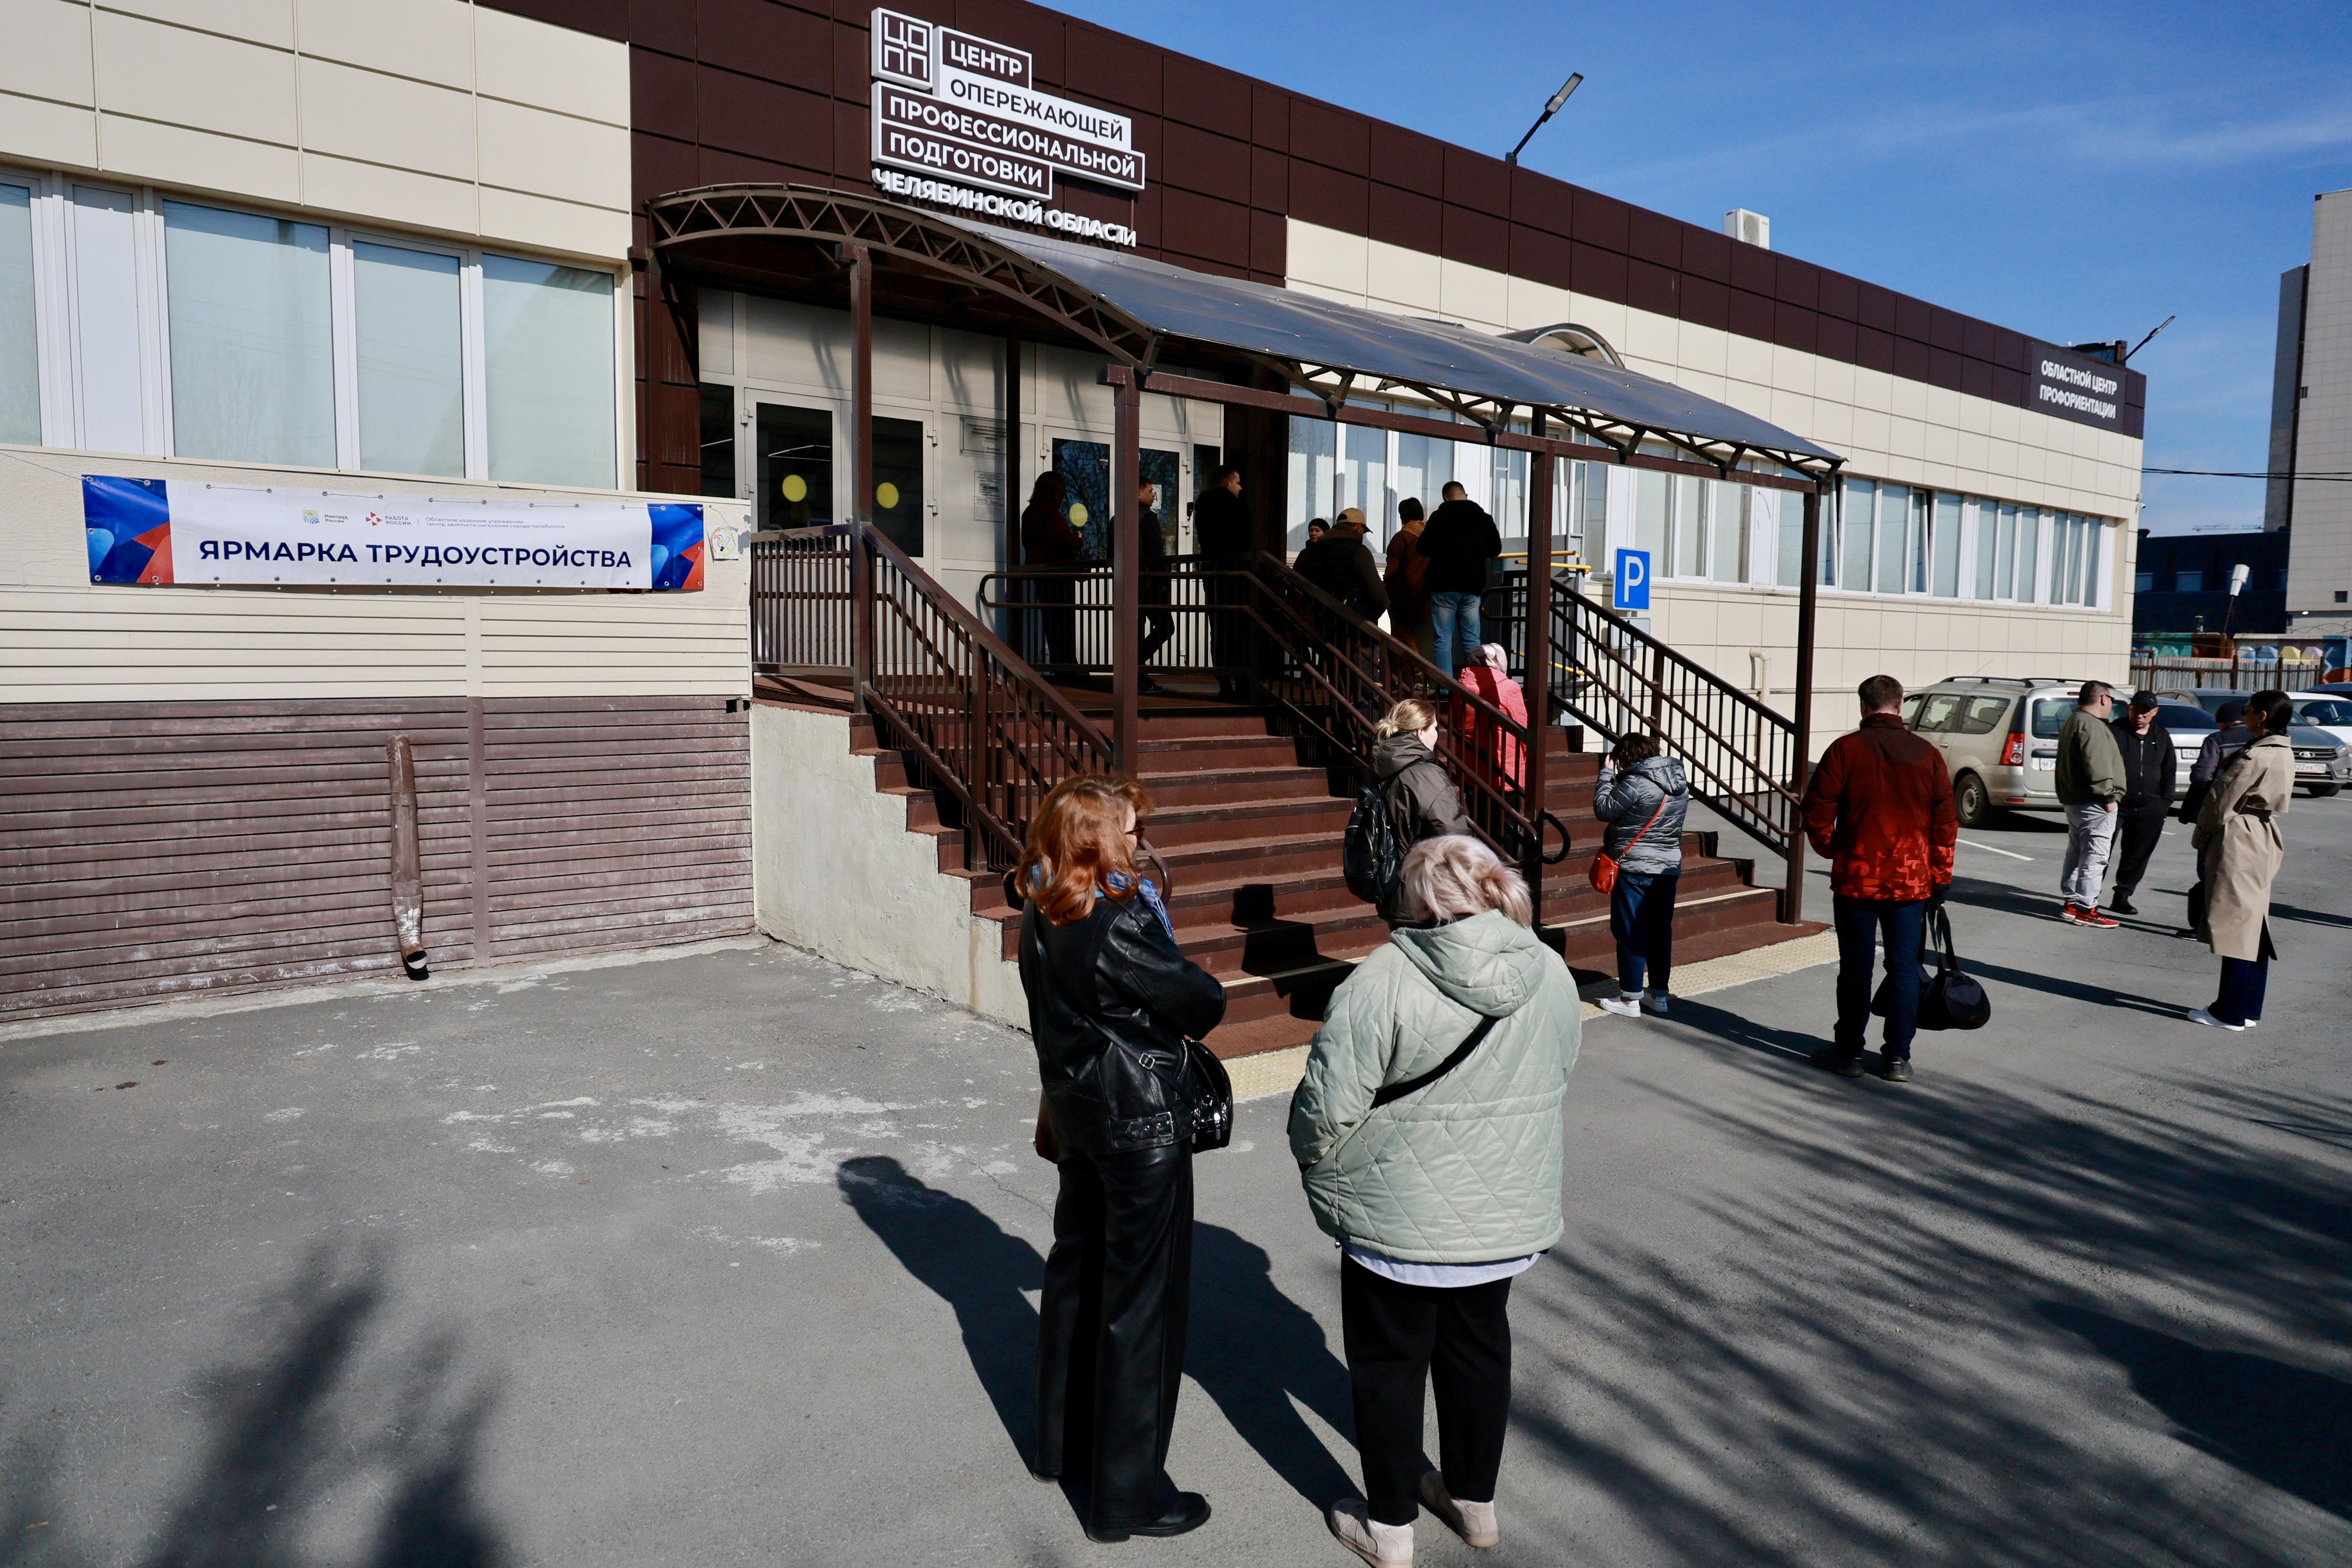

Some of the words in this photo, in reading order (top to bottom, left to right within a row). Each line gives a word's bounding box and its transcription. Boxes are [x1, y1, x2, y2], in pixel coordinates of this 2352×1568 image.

[950, 40, 1023, 77] ЦЕНТР
[950, 79, 1123, 142] ОПЕРЕЖАЮЩЕЙ
[890, 95, 1135, 178] ПРОФЕССИОНАЛЬНОЙ
[890, 131, 1043, 188] ПОДГОТОВКИ
[873, 168, 1043, 226] ЧЕЛЯБИНСКОЙ
[1044, 209, 1136, 247] ОБЛАСТИ
[2041, 360, 2091, 388] ОБЛАСТНОЙ
[2092, 375, 2118, 396] ЦЕНТР
[2040, 384, 2116, 419] ПРОФОРИЕНТАЦИИ
[200, 540, 358, 562] ЯРМАРКА
[366, 544, 632, 567] ТРУДОУСТРОЙСТВА
[1624, 556, 1644, 602] P
